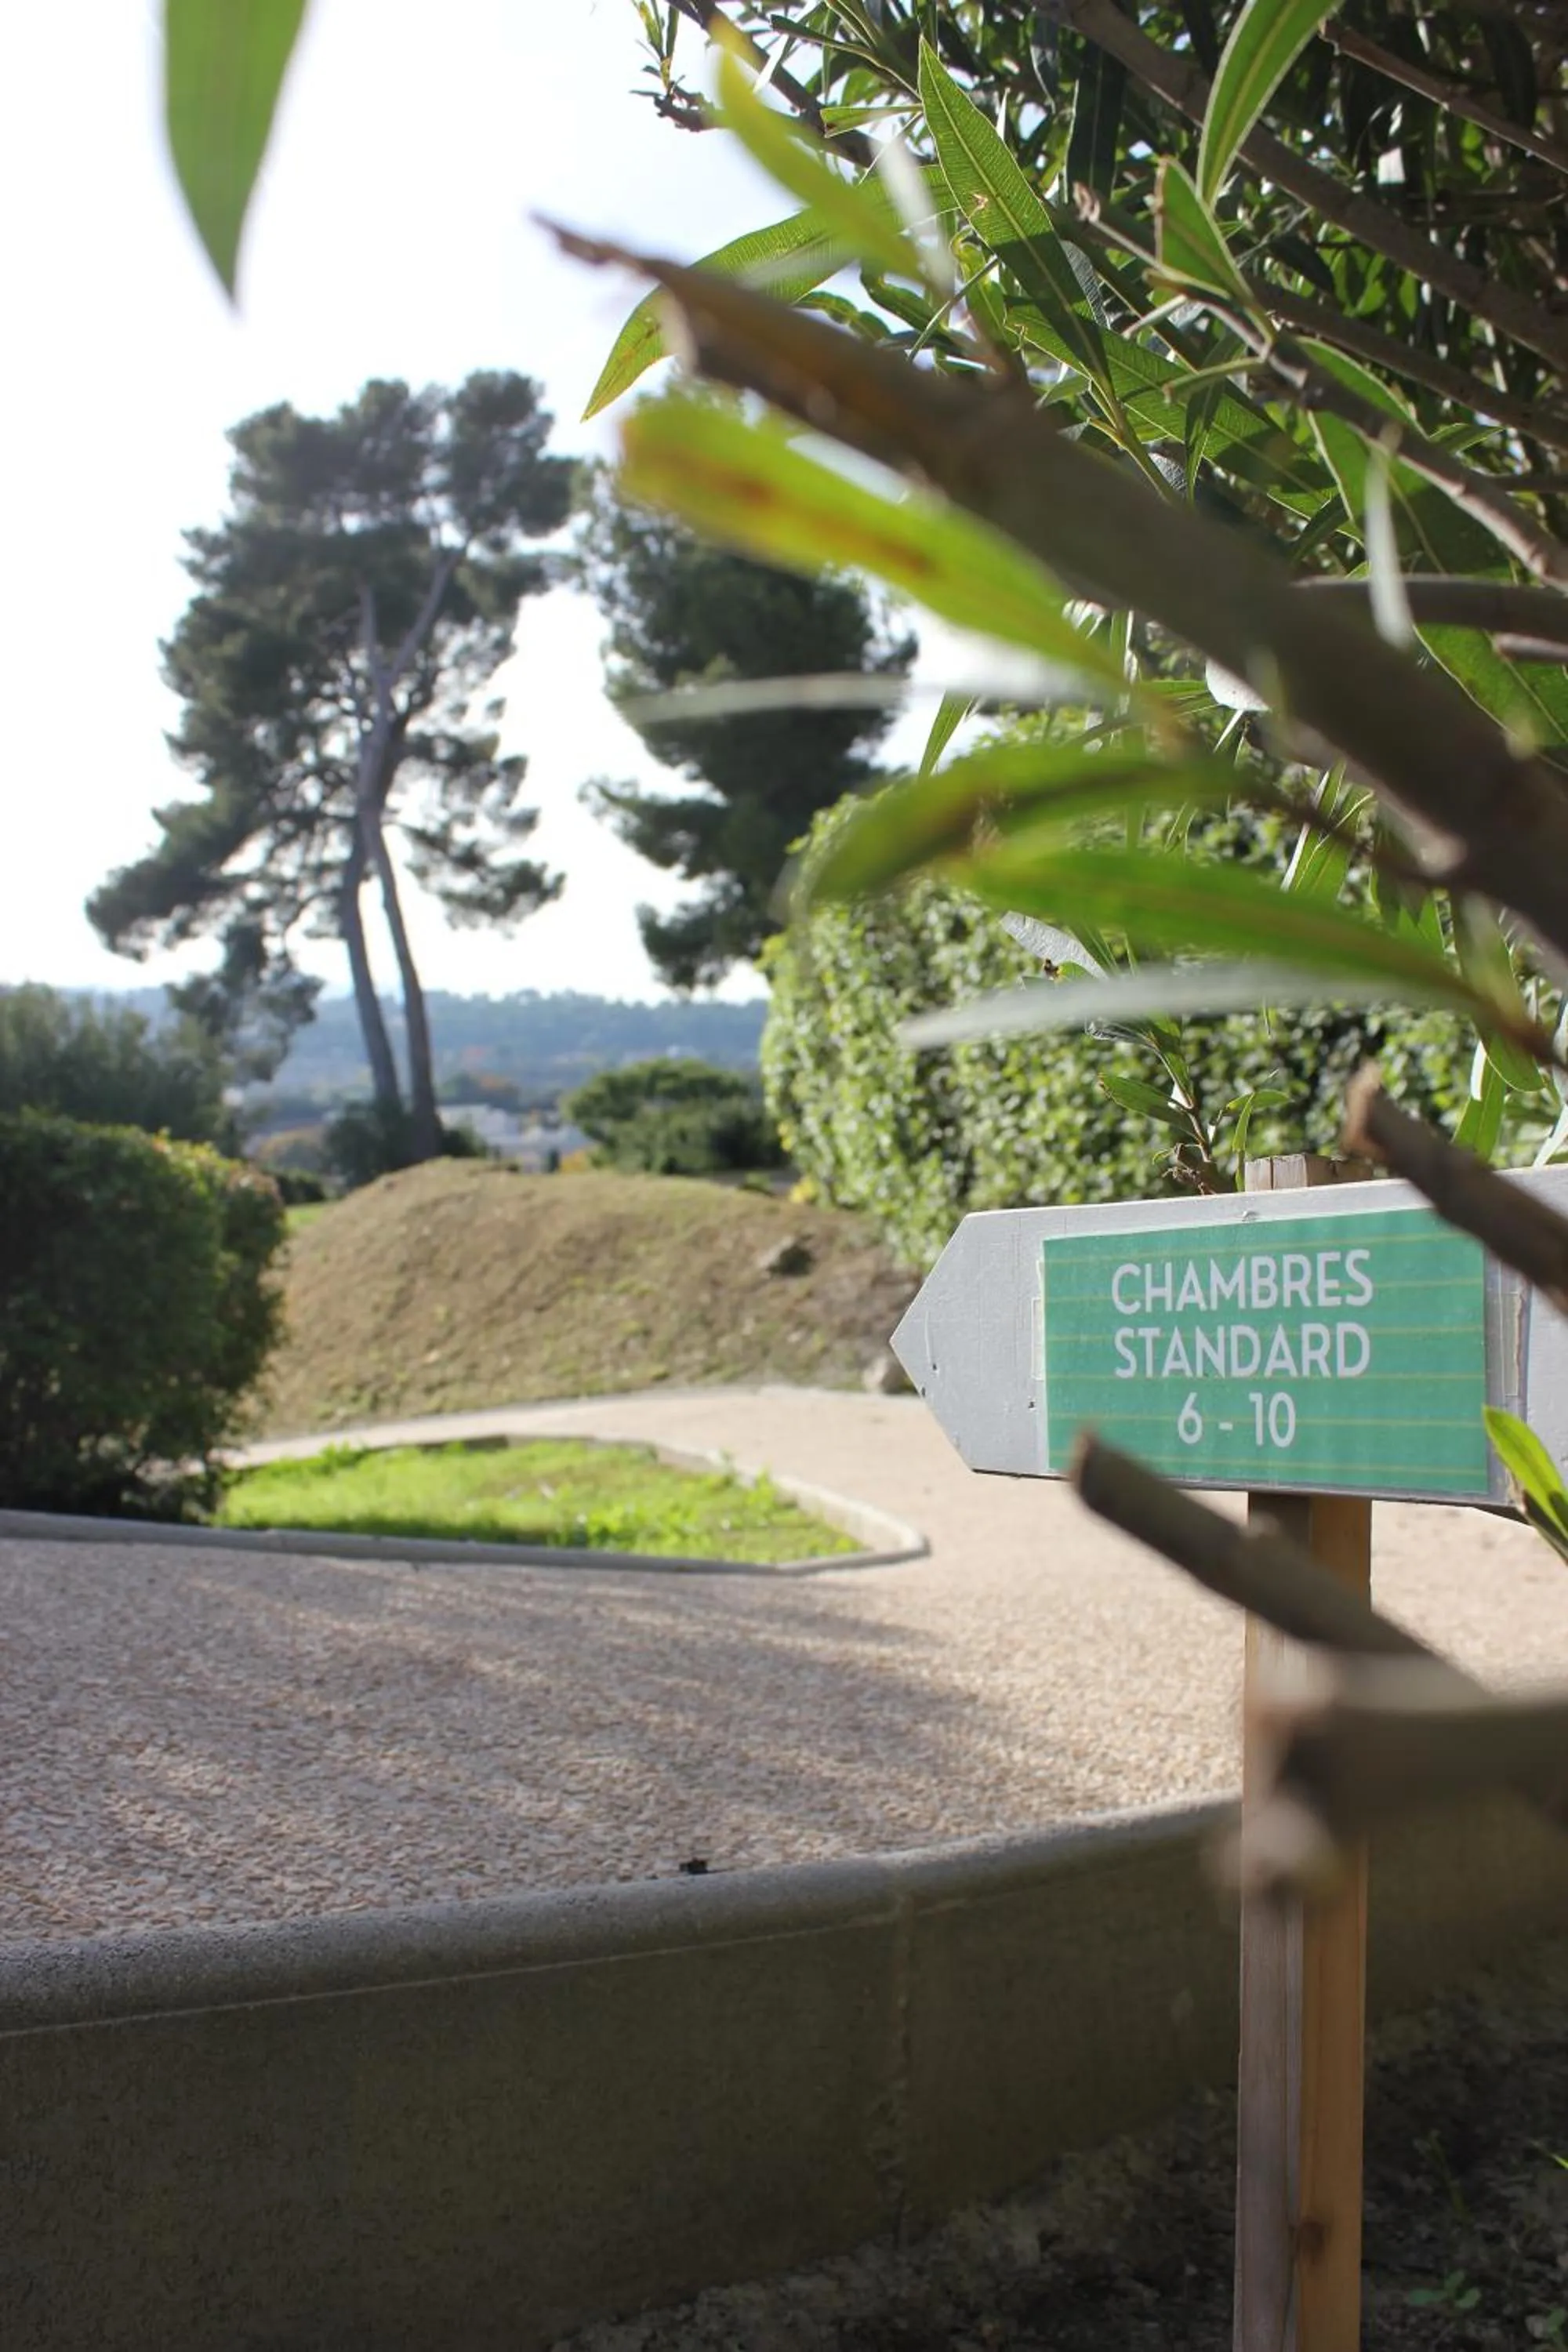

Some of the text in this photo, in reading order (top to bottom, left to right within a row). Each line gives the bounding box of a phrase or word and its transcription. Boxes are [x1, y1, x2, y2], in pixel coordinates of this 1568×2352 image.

[1111, 1249, 1374, 1315] CHAMBRES
[1114, 1322, 1371, 1379] STANDARD
[1177, 1392, 1203, 1444] 6
[1249, 1392, 1296, 1448] 10
